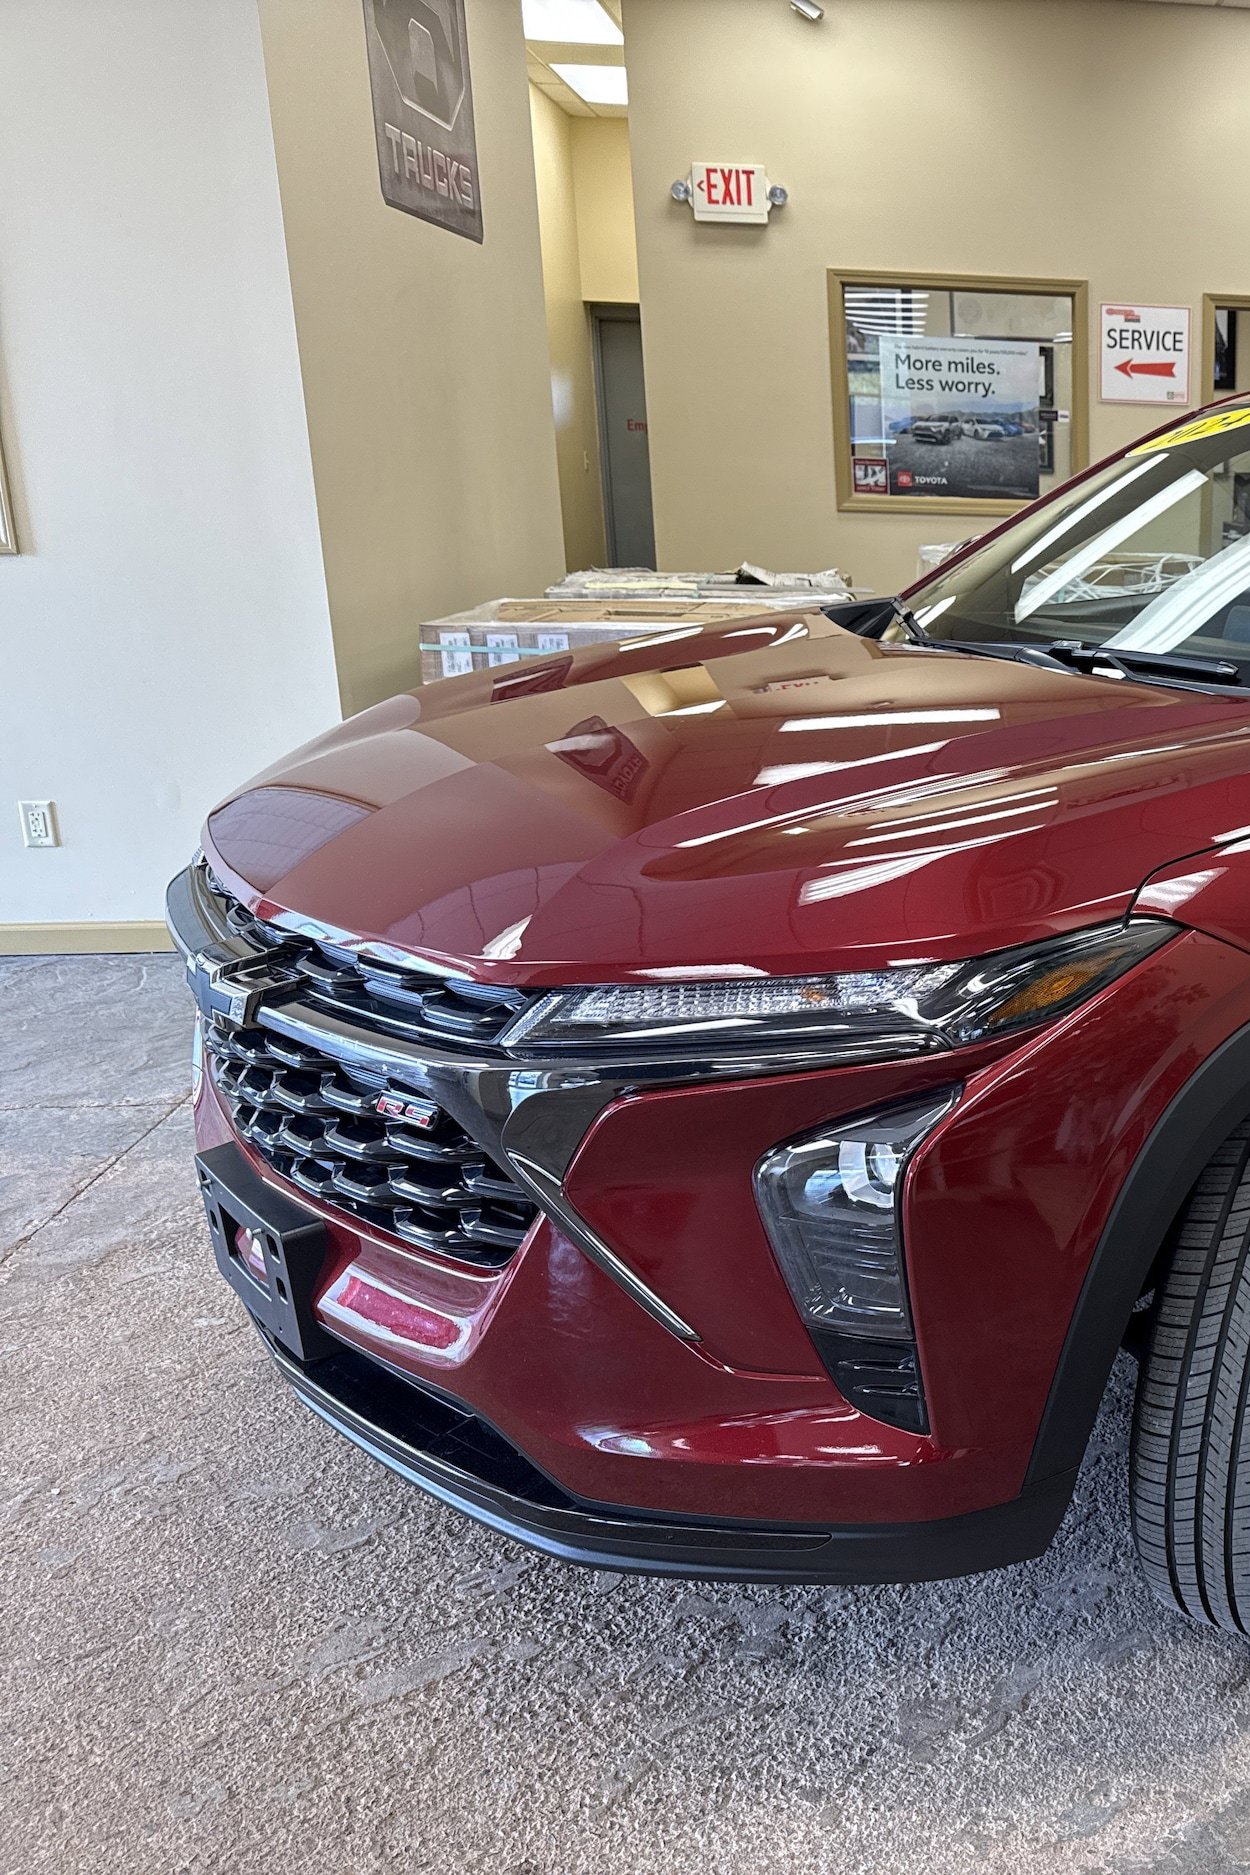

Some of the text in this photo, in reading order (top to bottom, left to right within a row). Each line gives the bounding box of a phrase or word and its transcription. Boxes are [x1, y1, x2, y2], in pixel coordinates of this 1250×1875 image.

[384, 122, 475, 210] TRUCKS
[705, 168, 755, 206] EXIT
[1106, 328, 1184, 352] SERVICE
[895, 353, 1001, 376] More miles.
[895, 373, 996, 399] Less worry.
[914, 475, 948, 485] TOYOTA
[376, 1095, 433, 1128] RS
